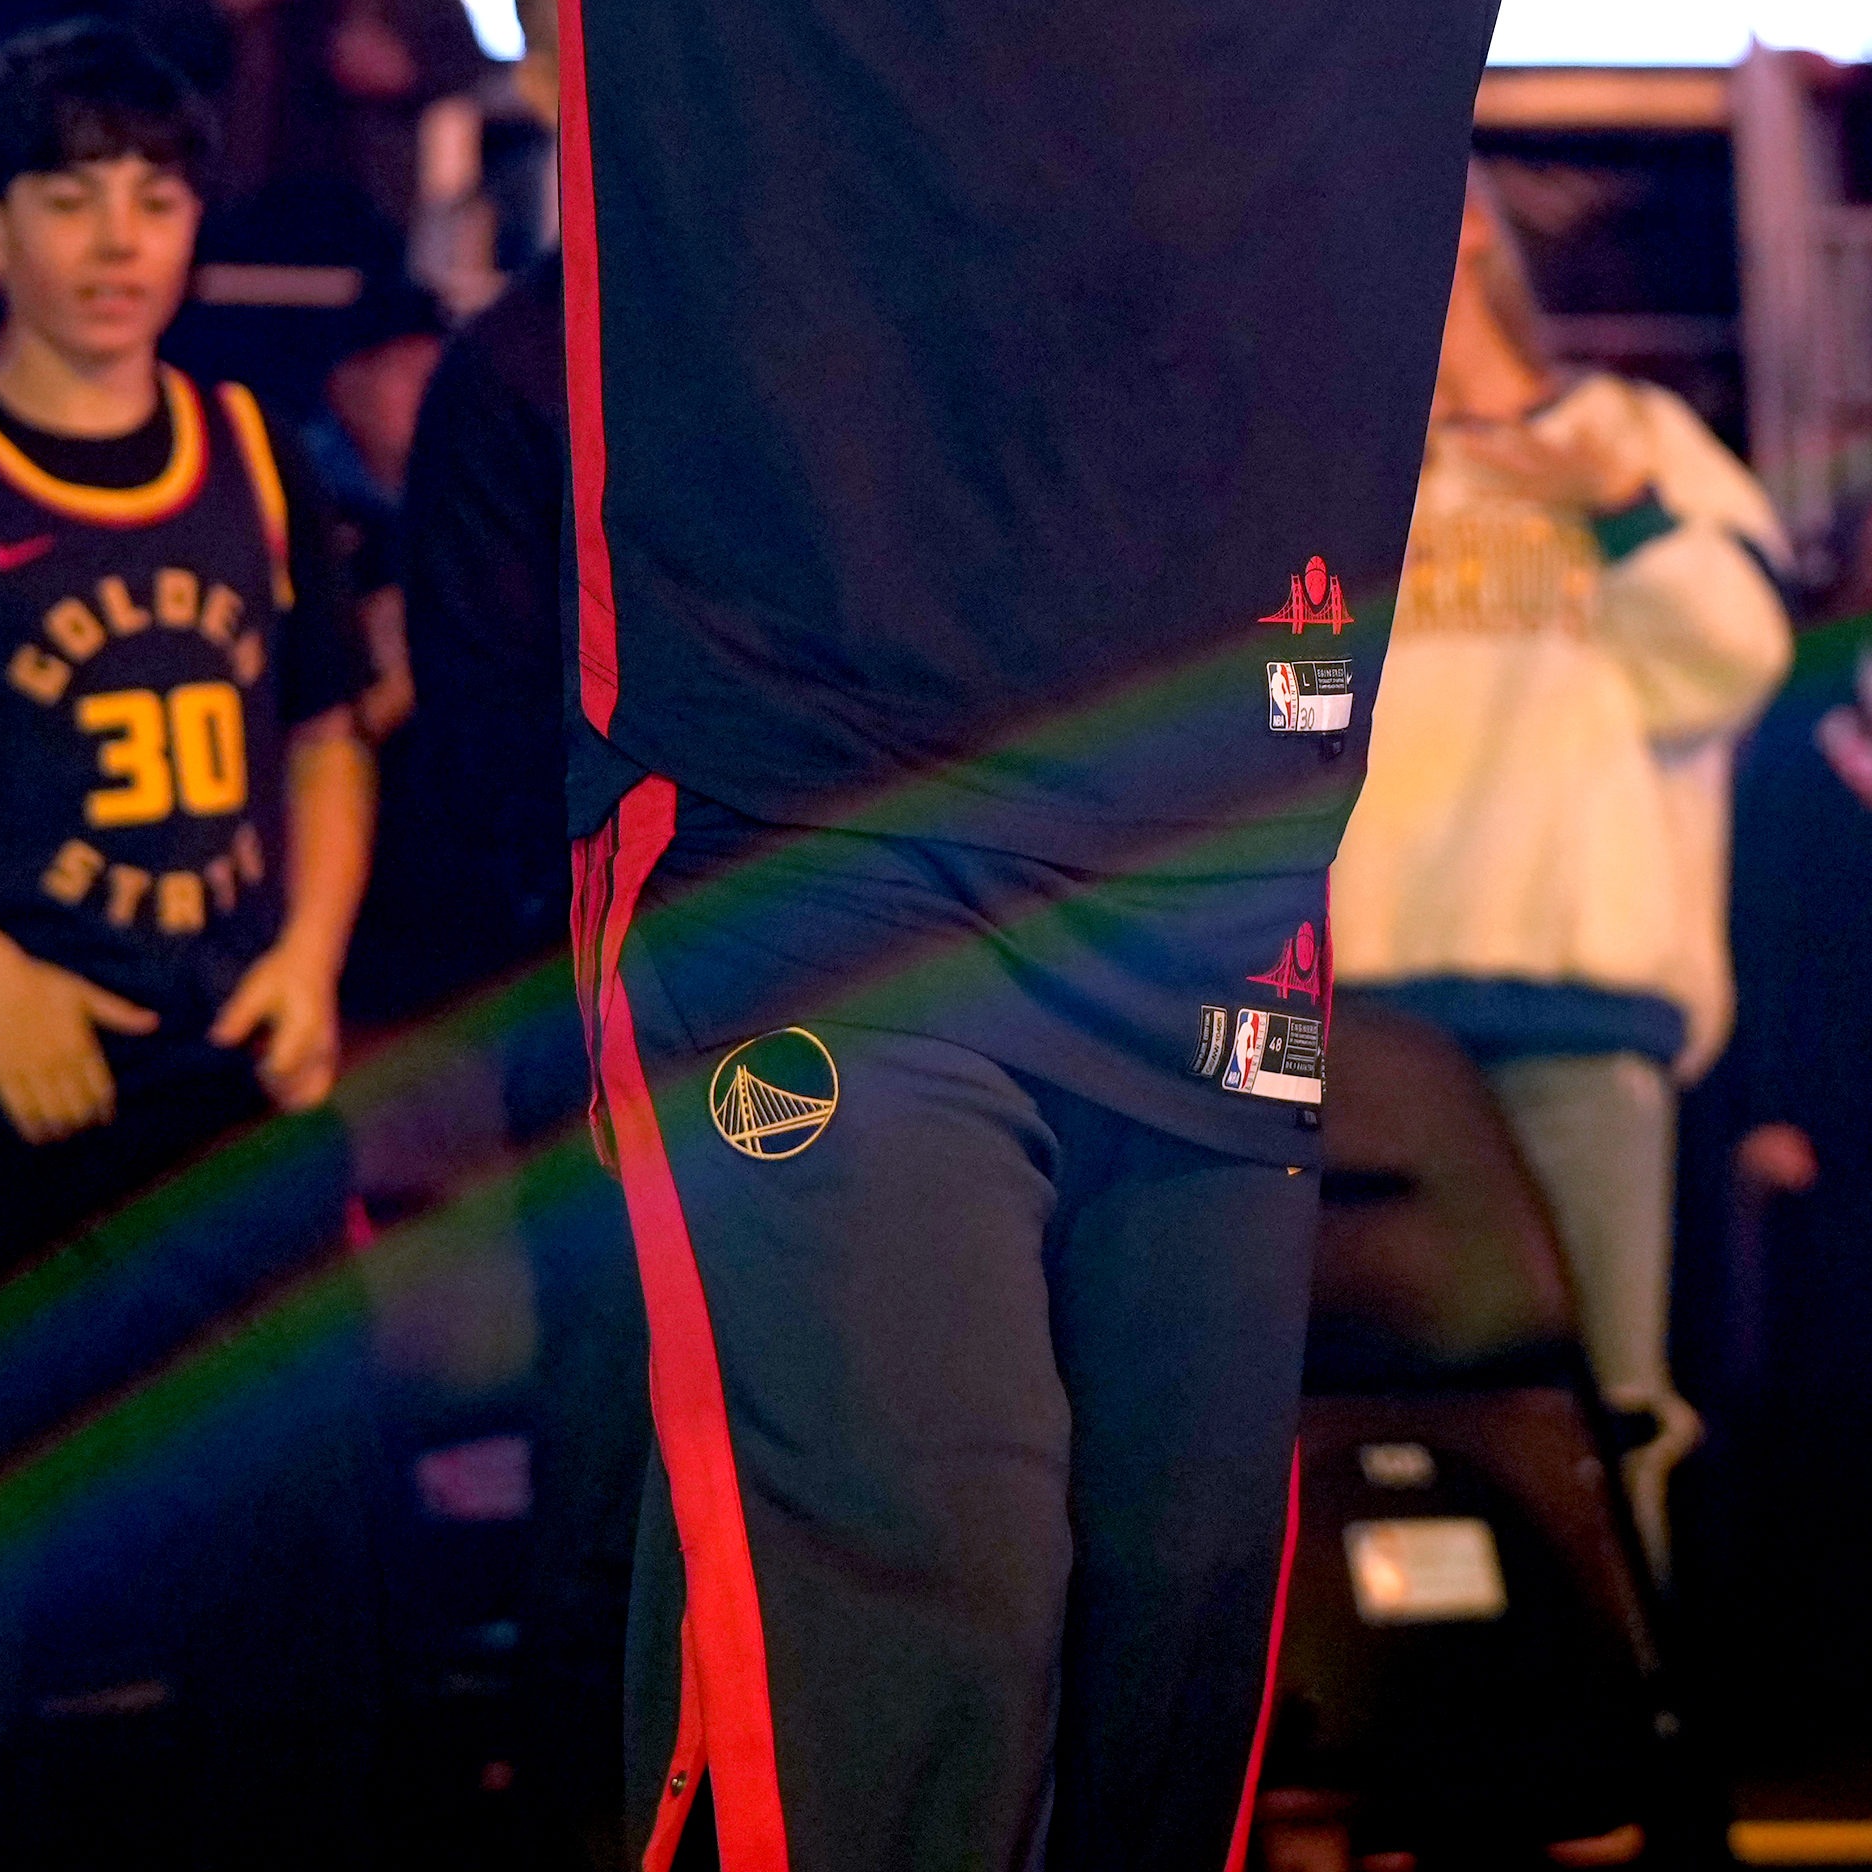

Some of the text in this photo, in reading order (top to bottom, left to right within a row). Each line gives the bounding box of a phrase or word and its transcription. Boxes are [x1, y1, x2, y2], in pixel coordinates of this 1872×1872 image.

[1299, 707, 1315, 730] 30
[73, 681, 250, 830] 30
[1268, 1036, 1284, 1053] 48
